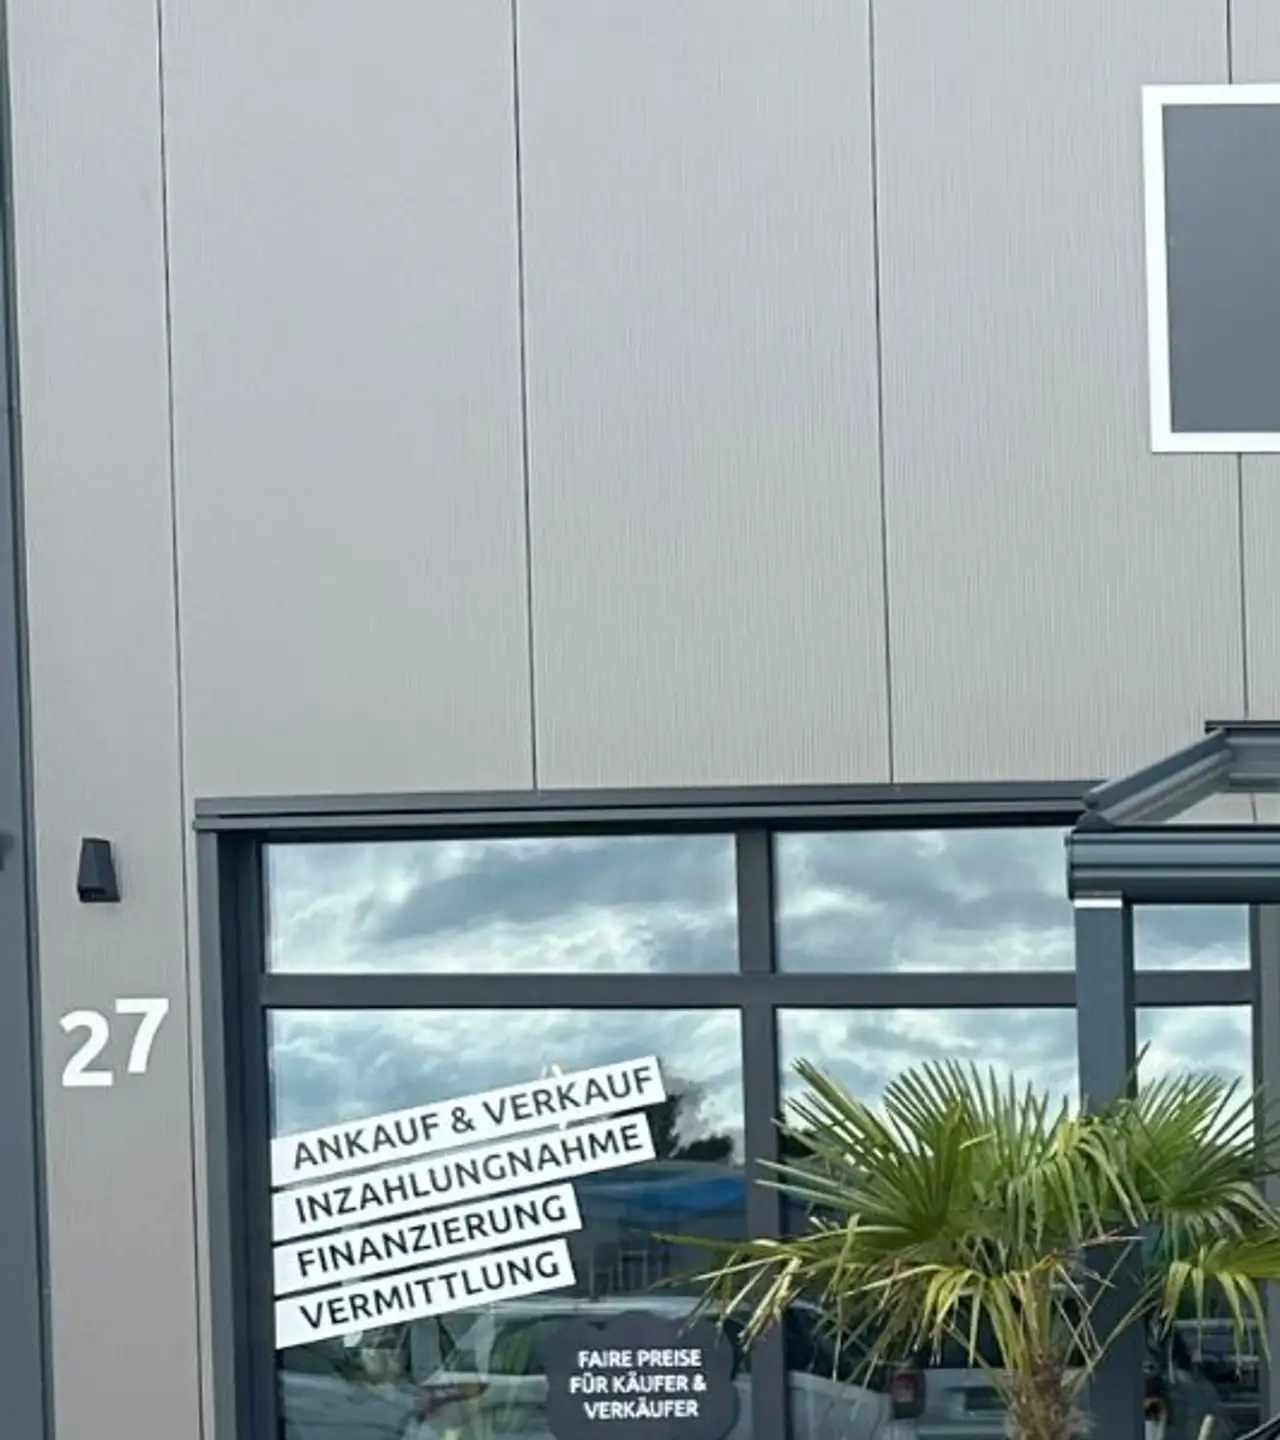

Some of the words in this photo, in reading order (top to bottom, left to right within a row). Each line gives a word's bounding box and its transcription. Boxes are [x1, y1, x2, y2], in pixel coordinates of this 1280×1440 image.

[58, 997, 171, 1088] 27
[293, 1112, 440, 1171] ANKAUF
[450, 1105, 477, 1134] &
[481, 1065, 655, 1125] VERKAUF
[294, 1123, 644, 1225] INZAHLUNGNAHME
[296, 1194, 567, 1277] FINANZIERUNG
[299, 1250, 561, 1330] VERMITTLUNG
[569, 1372, 609, 1394] FÜR
[611, 1370, 690, 1393] KÄUFER
[692, 1372, 708, 1392] &
[578, 1349, 634, 1368] FAIRE
[636, 1348, 702, 1367] PREISE
[583, 1396, 699, 1420] VERKÄUFER
